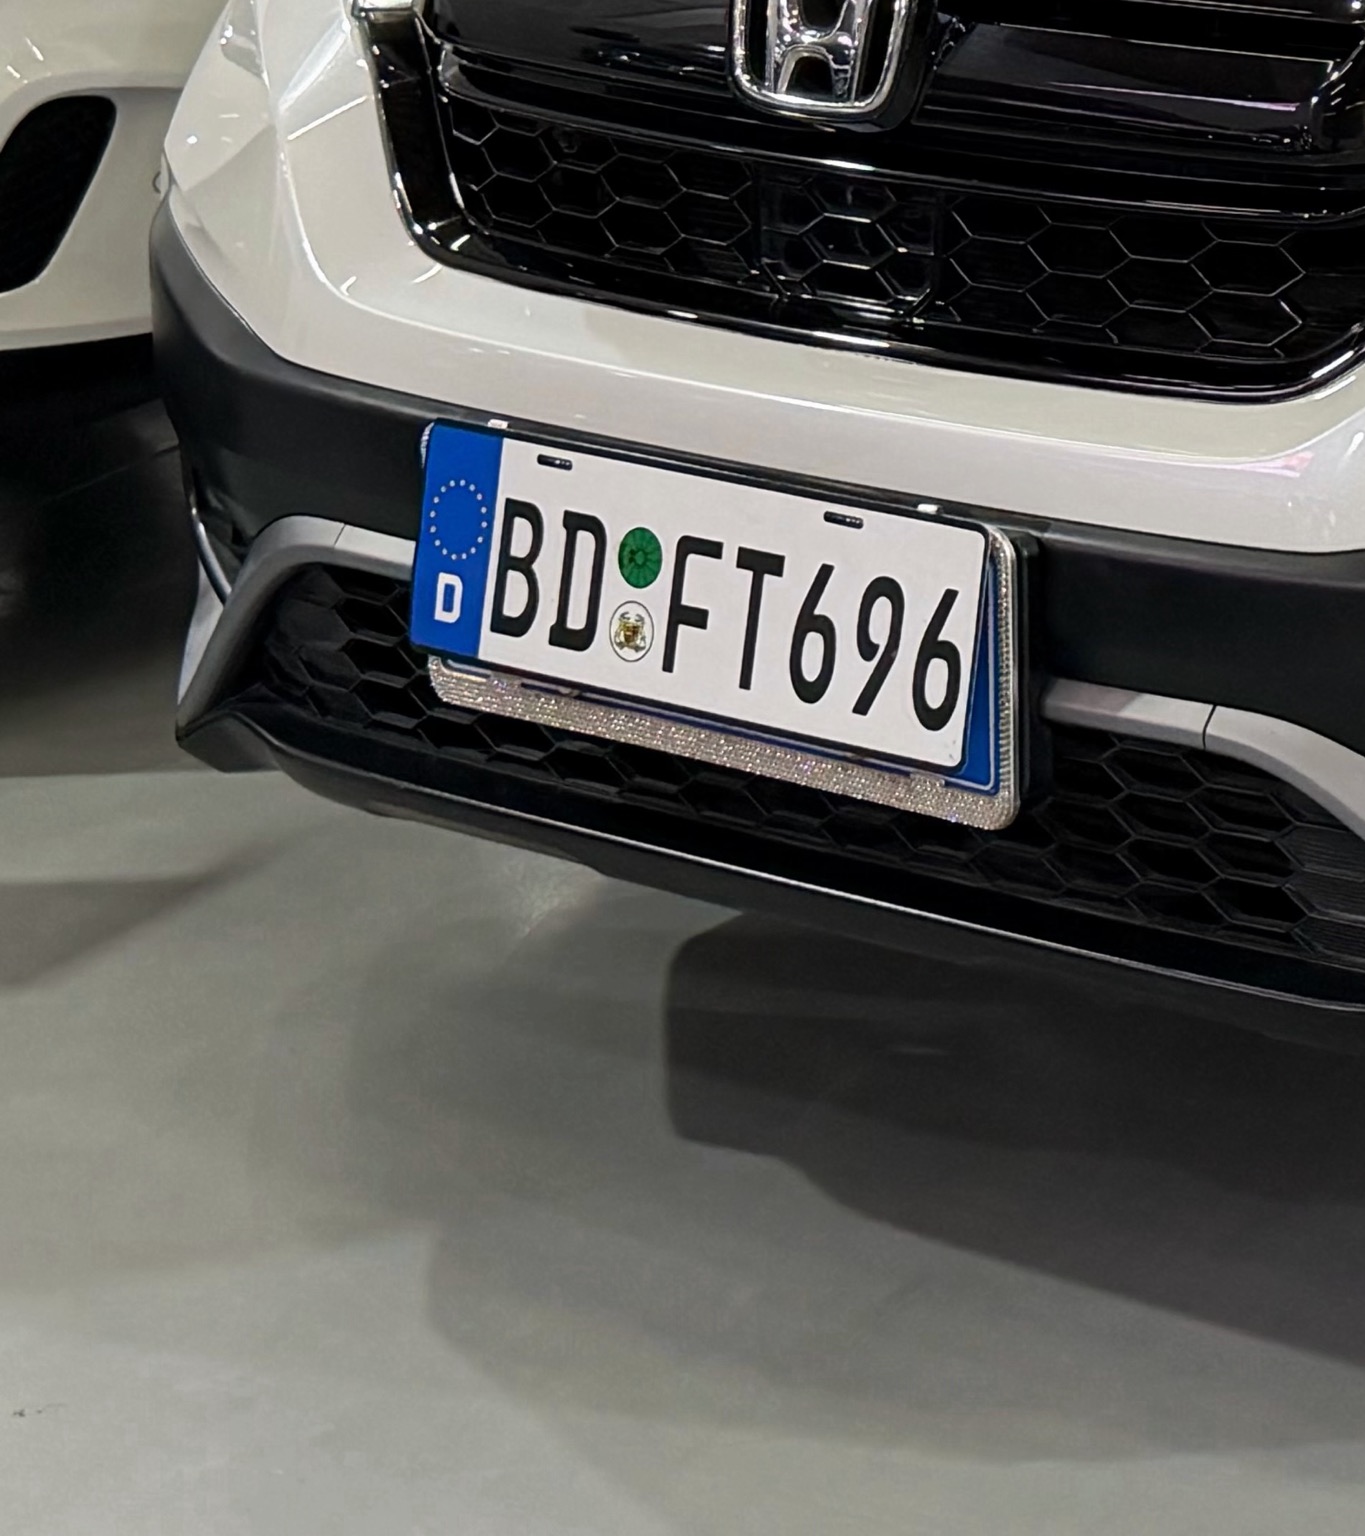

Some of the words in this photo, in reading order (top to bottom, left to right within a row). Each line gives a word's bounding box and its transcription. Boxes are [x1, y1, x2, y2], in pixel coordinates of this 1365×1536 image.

[434, 571, 464, 625] D
[490, 497, 607, 653] BD
[661, 534, 962, 732] FT696
